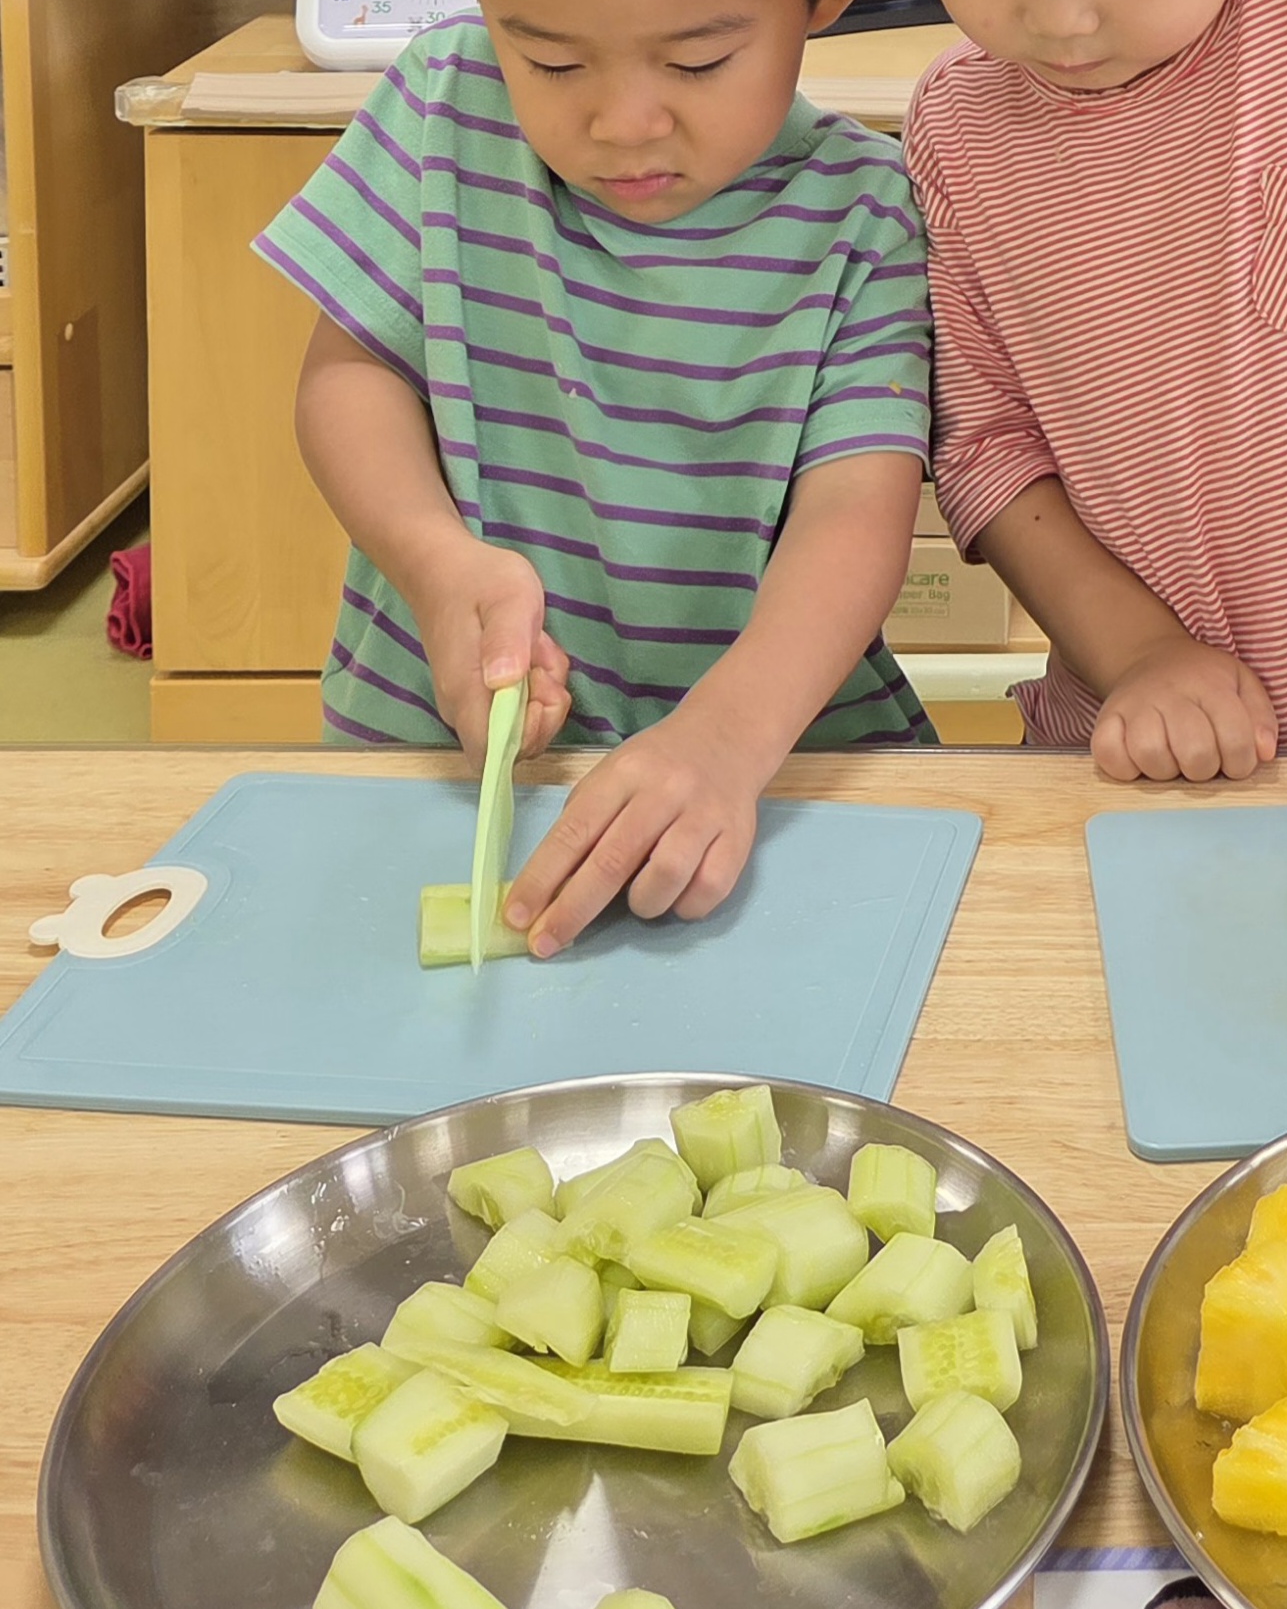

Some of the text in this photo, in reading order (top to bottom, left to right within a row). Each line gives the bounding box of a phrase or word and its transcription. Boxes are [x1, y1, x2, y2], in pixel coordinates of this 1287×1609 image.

[371, 1, 392, 14] 35
[426, 11, 446, 24] 30
[905, 572, 950, 586] care
